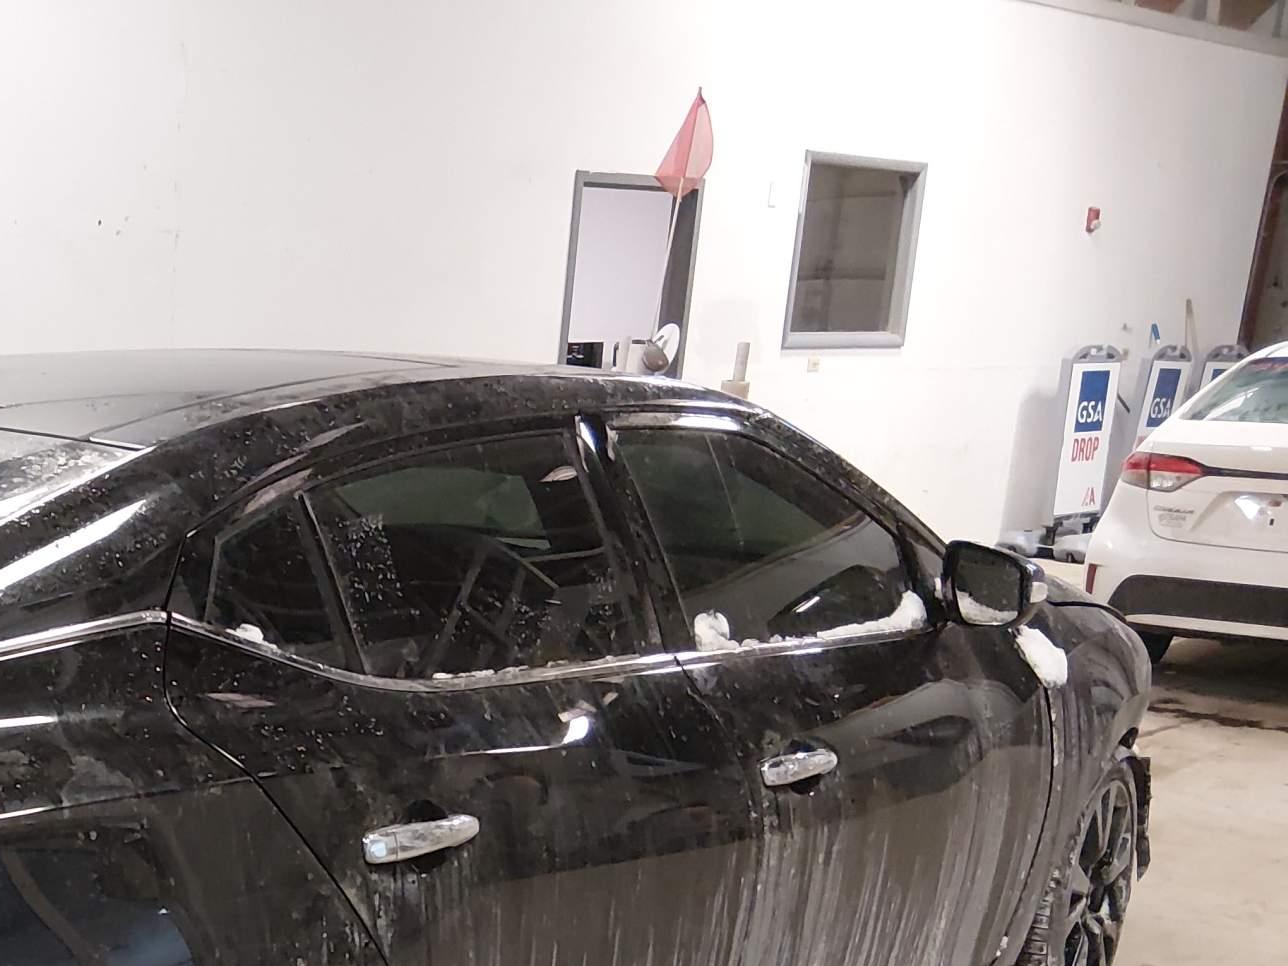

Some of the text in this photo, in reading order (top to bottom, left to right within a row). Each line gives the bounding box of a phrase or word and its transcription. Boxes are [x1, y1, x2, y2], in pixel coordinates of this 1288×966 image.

[1077, 400, 1103, 423] GSA
[1150, 398, 1172, 419] GSA
[1072, 436, 1100, 462] DROP
